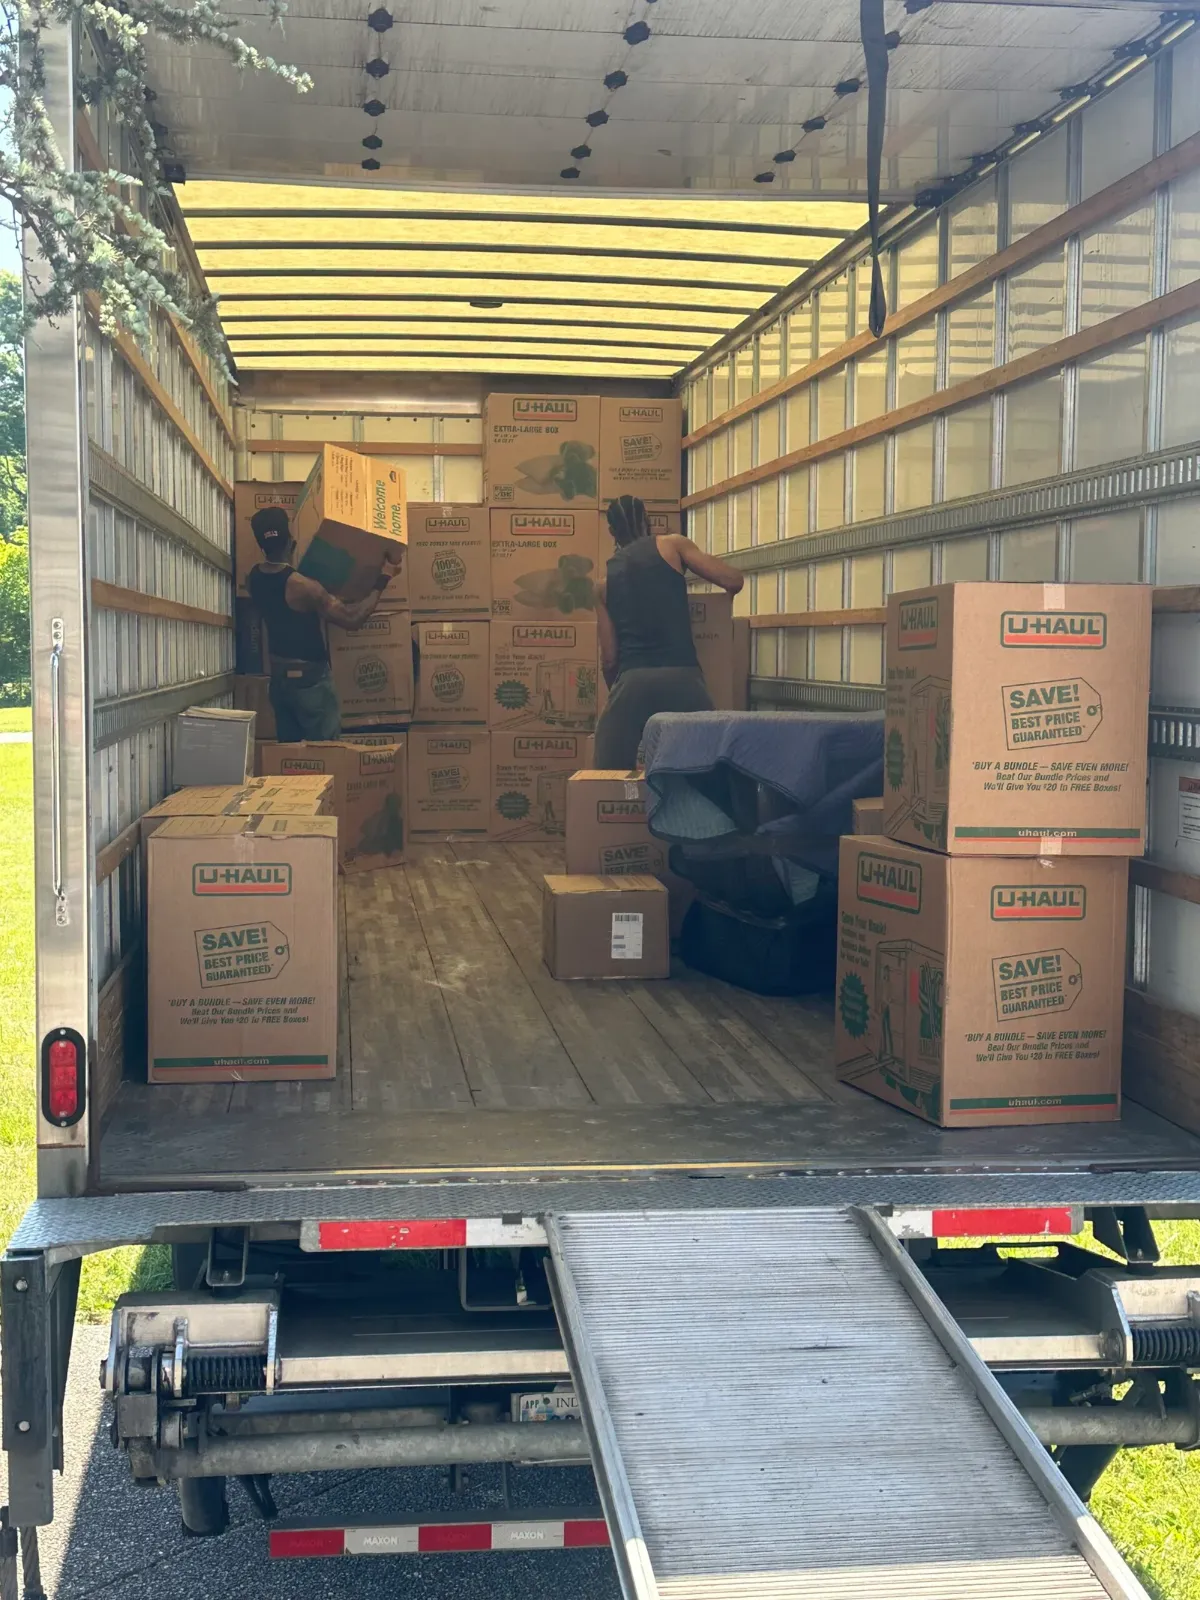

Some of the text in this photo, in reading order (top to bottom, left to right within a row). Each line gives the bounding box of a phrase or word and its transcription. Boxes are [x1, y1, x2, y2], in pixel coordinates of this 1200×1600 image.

[516, 401, 574, 413] U-HAUL
[621, 409, 661, 417] U-HAUL
[493, 425, 543, 434] EXTRA-LARGE
[623, 436, 652, 447] SAVE!
[371, 479, 388, 530] Welcome
[389, 503, 402, 537] home.
[428, 519, 467, 527] U-HAUL
[514, 516, 571, 528] U-HAUL
[491, 540, 541, 548] EXTRA-LARGE
[435, 558, 461, 572] 100%
[900, 606, 936, 631] U-HAUL
[1007, 617, 1101, 635] U-HAUL
[428, 632, 467, 640] U-HAUL
[516, 629, 573, 639] U-HAUL
[434, 671, 460, 684] 100%
[1009, 684, 1080, 709] SAVE!
[1011, 711, 1081, 730] BEST PRICE
[429, 741, 468, 749] U-HAUL
[518, 739, 574, 751] U-HAUL
[284, 761, 321, 770] U-HAUL
[994, 761, 1001, 770] A
[1003, 762, 1038, 771] BUNDLE
[1050, 762, 1073, 771] SAVE
[1075, 762, 1098, 771] EVEN
[1100, 762, 1129, 772] MORE!
[431, 767, 460, 779] SAVE!
[996, 772, 1110, 782] Beat Our Bundle Prices and
[983, 781, 1005, 791] We'll
[1006, 782, 1025, 791] Give
[1026, 782, 1041, 791] You
[1043, 783, 1058, 792] $20
[1070, 783, 1092, 792] FREE
[1093, 783, 1122, 792] Boxes!
[601, 803, 646, 814] U-HA
[1018, 828, 1077, 837] uhaul.com
[603, 845, 649, 862] SAVE!
[199, 868, 286, 884] U-HAUL
[860, 859, 918, 893] U-HAUL
[997, 890, 1081, 907] U-HAUL
[202, 927, 268, 951] SAVE!
[204, 951, 270, 970] BEST PRICE
[998, 954, 1062, 981] SAVE!
[1000, 981, 1062, 1001] BEST PRICE
[189, 998, 196, 1007] A
[197, 998, 231, 1007] BUNDLE
[242, 997, 263, 1006] SAVE
[265, 997, 287, 1006] EVEN
[288, 996, 316, 1005] MORE!
[227, 1007, 255, 1015] Bundle
[283, 1006, 299, 1014] and
[220, 1016, 235, 1024] You
[236, 1016, 249, 1024] $20
[261, 1015, 281, 1024] FREE
[283, 1015, 309, 1024] Boxes!
[985, 1032, 992, 1042] A
[993, 1032, 1026, 1041] BUNDLE
[1036, 1031, 1058, 1040] SAVE
[1058, 1030, 1079, 1040] EVEN
[1080, 1029, 1108, 1039] MORE!
[987, 1040, 1090, 1052] Beat Our Bundle Prices and
[213, 1058, 270, 1066] uhaul.com
[976, 1053, 995, 1062] We'll
[996, 1053, 1013, 1062] Give
[1015, 1052, 1029, 1061] You
[1030, 1052, 1043, 1061] $20
[1054, 1051, 1074, 1060] FREE
[1075, 1050, 1101, 1060] Boxes!
[1008, 1098, 1062, 1106] uhaul.com
[525, 1399, 540, 1410] APP
[362, 1531, 545, 1546] MAXON MAXON
